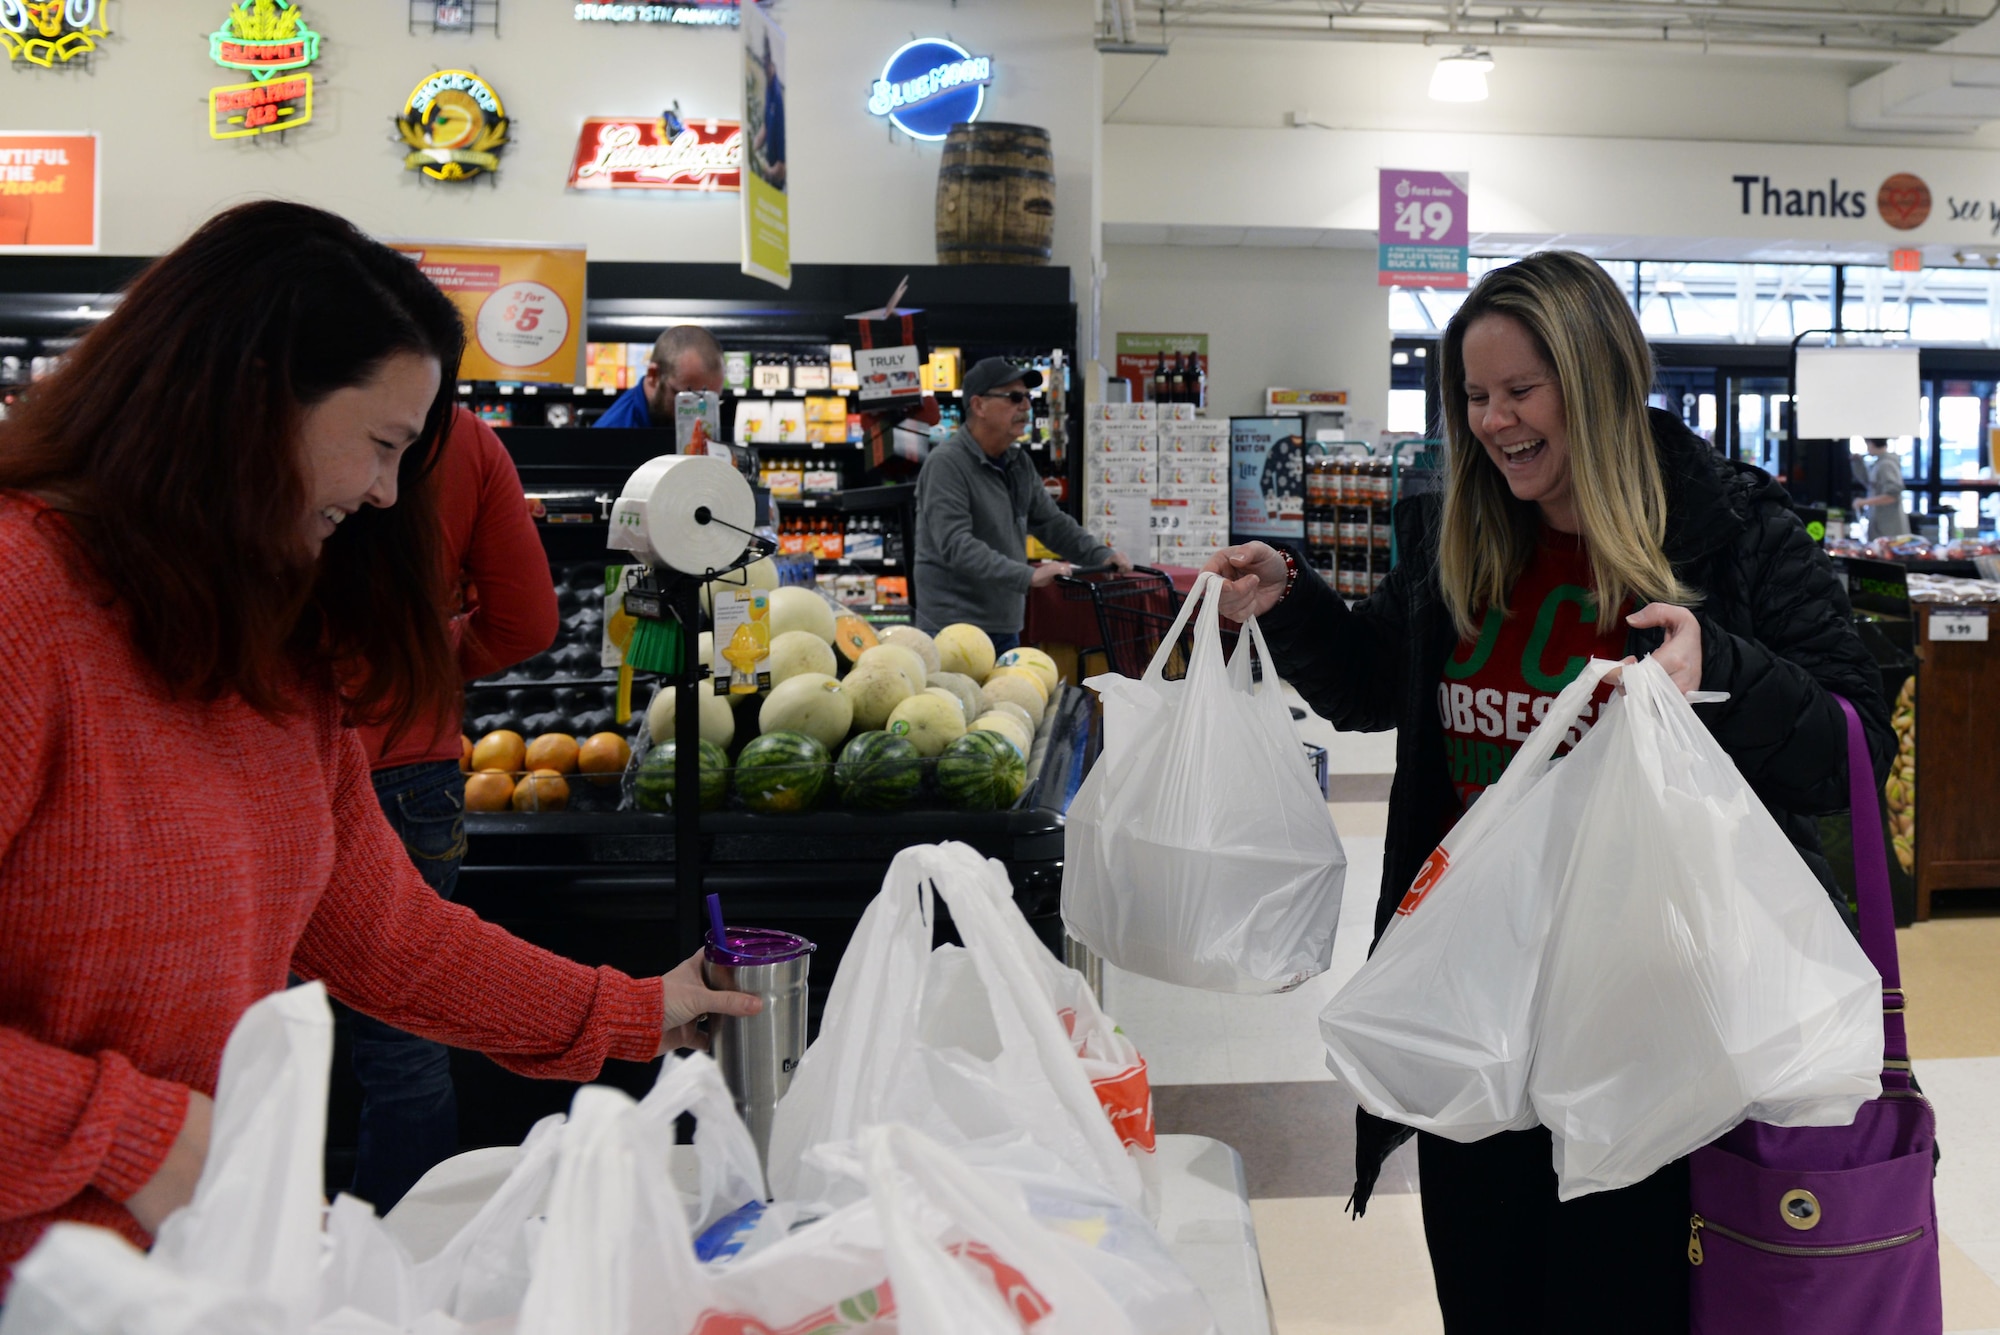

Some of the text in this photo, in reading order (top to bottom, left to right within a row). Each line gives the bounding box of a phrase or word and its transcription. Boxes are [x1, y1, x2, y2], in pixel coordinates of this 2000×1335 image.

[438, 8, 462, 22] NFL
[574, 4, 636, 21] STURGIS
[221, 42, 305, 60] SUMMIT
[245, 104, 278, 128] ALE
[1732, 175, 1867, 218] Thanks
[430, 277, 465, 286] URDAY
[521, 291, 545, 304] for
[869, 354, 906, 367] TRULY
[1121, 356, 1146, 368] Things
[763, 372, 780, 385] IPA
